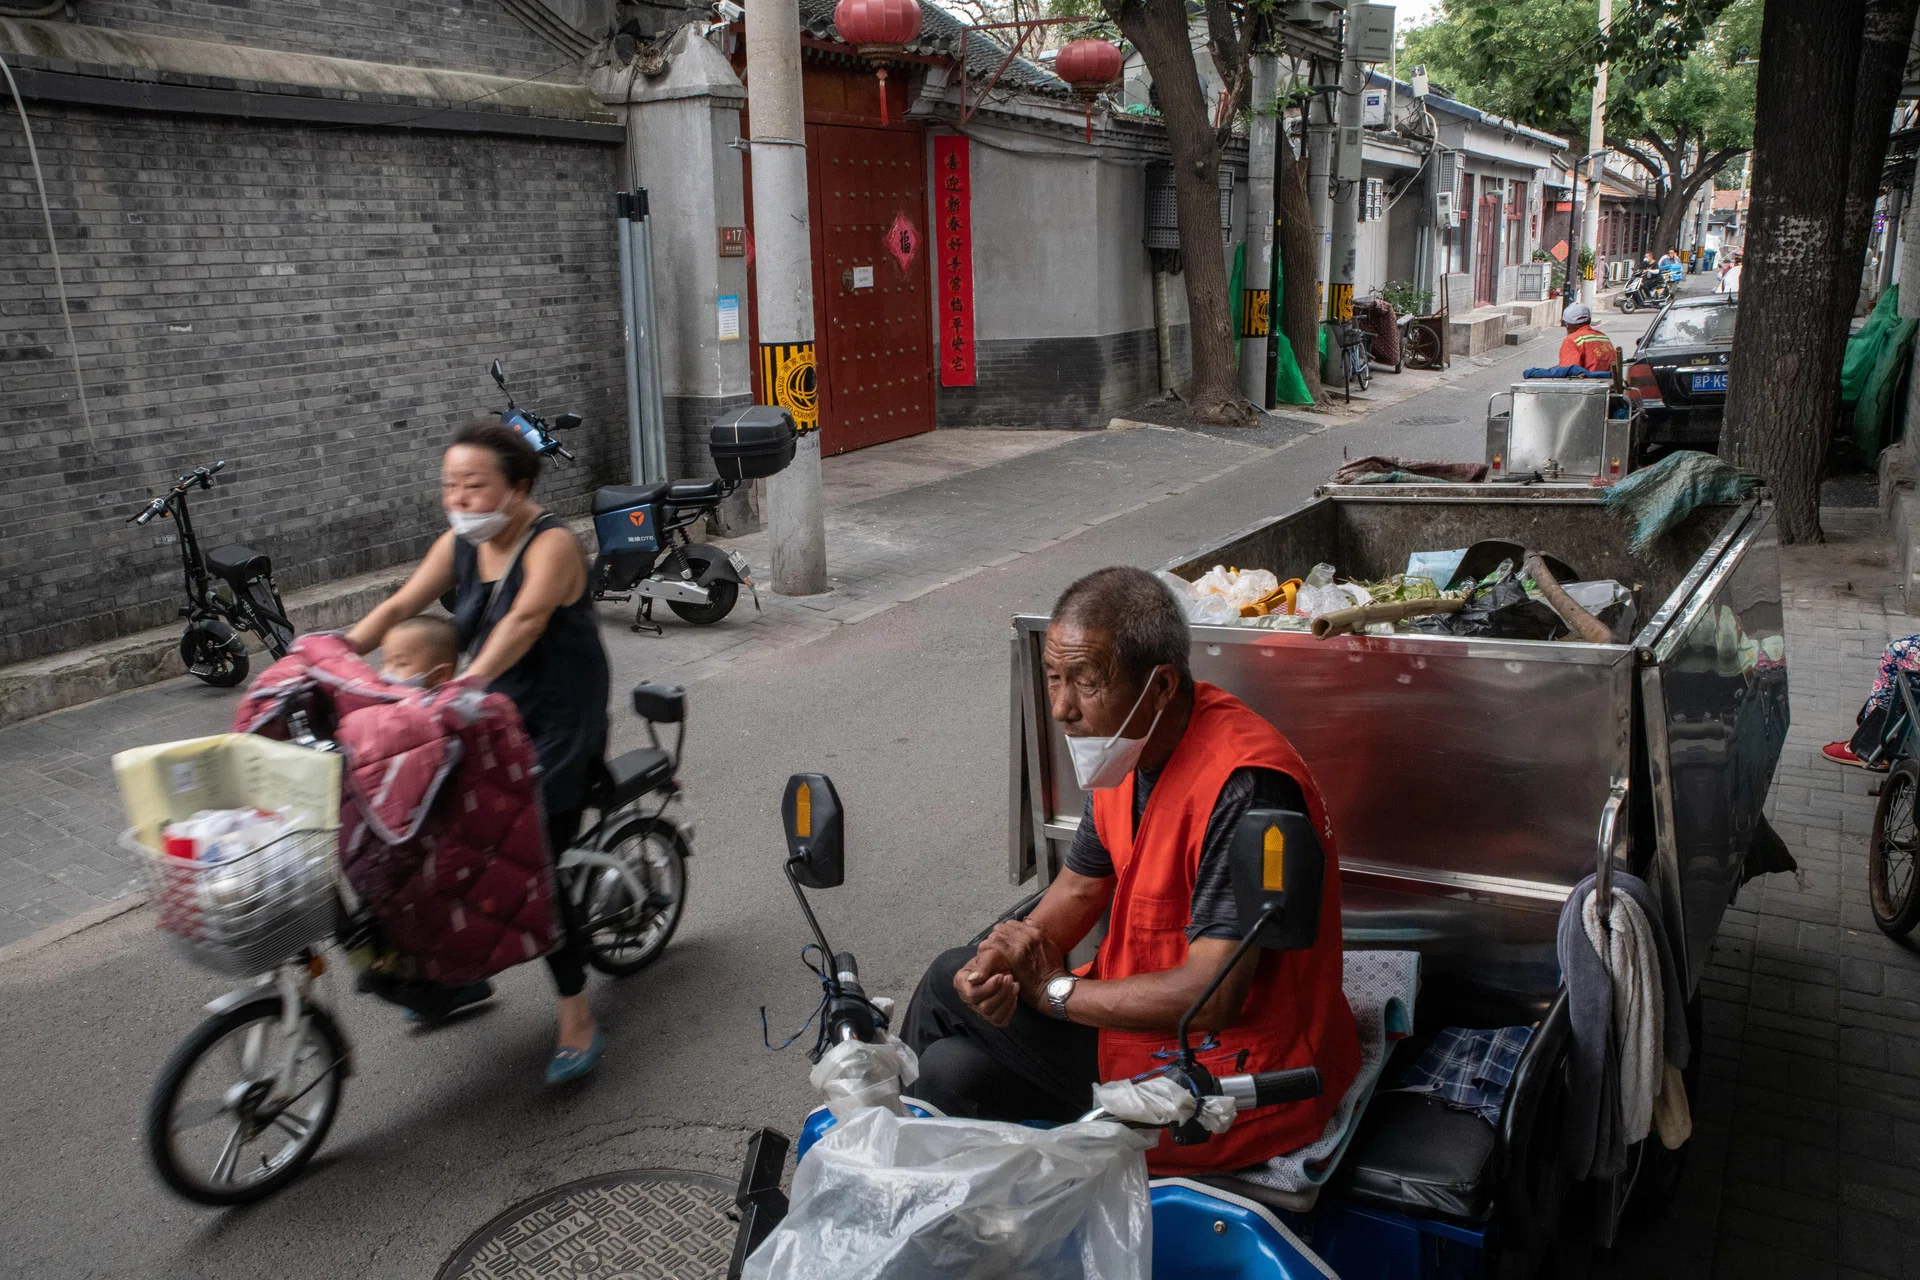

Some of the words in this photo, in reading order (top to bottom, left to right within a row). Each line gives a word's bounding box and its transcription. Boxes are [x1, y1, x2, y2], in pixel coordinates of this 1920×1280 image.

[732, 229, 742, 241] 17
[899, 229, 911, 254] 福
[777, 375, 786, 397] STATE
